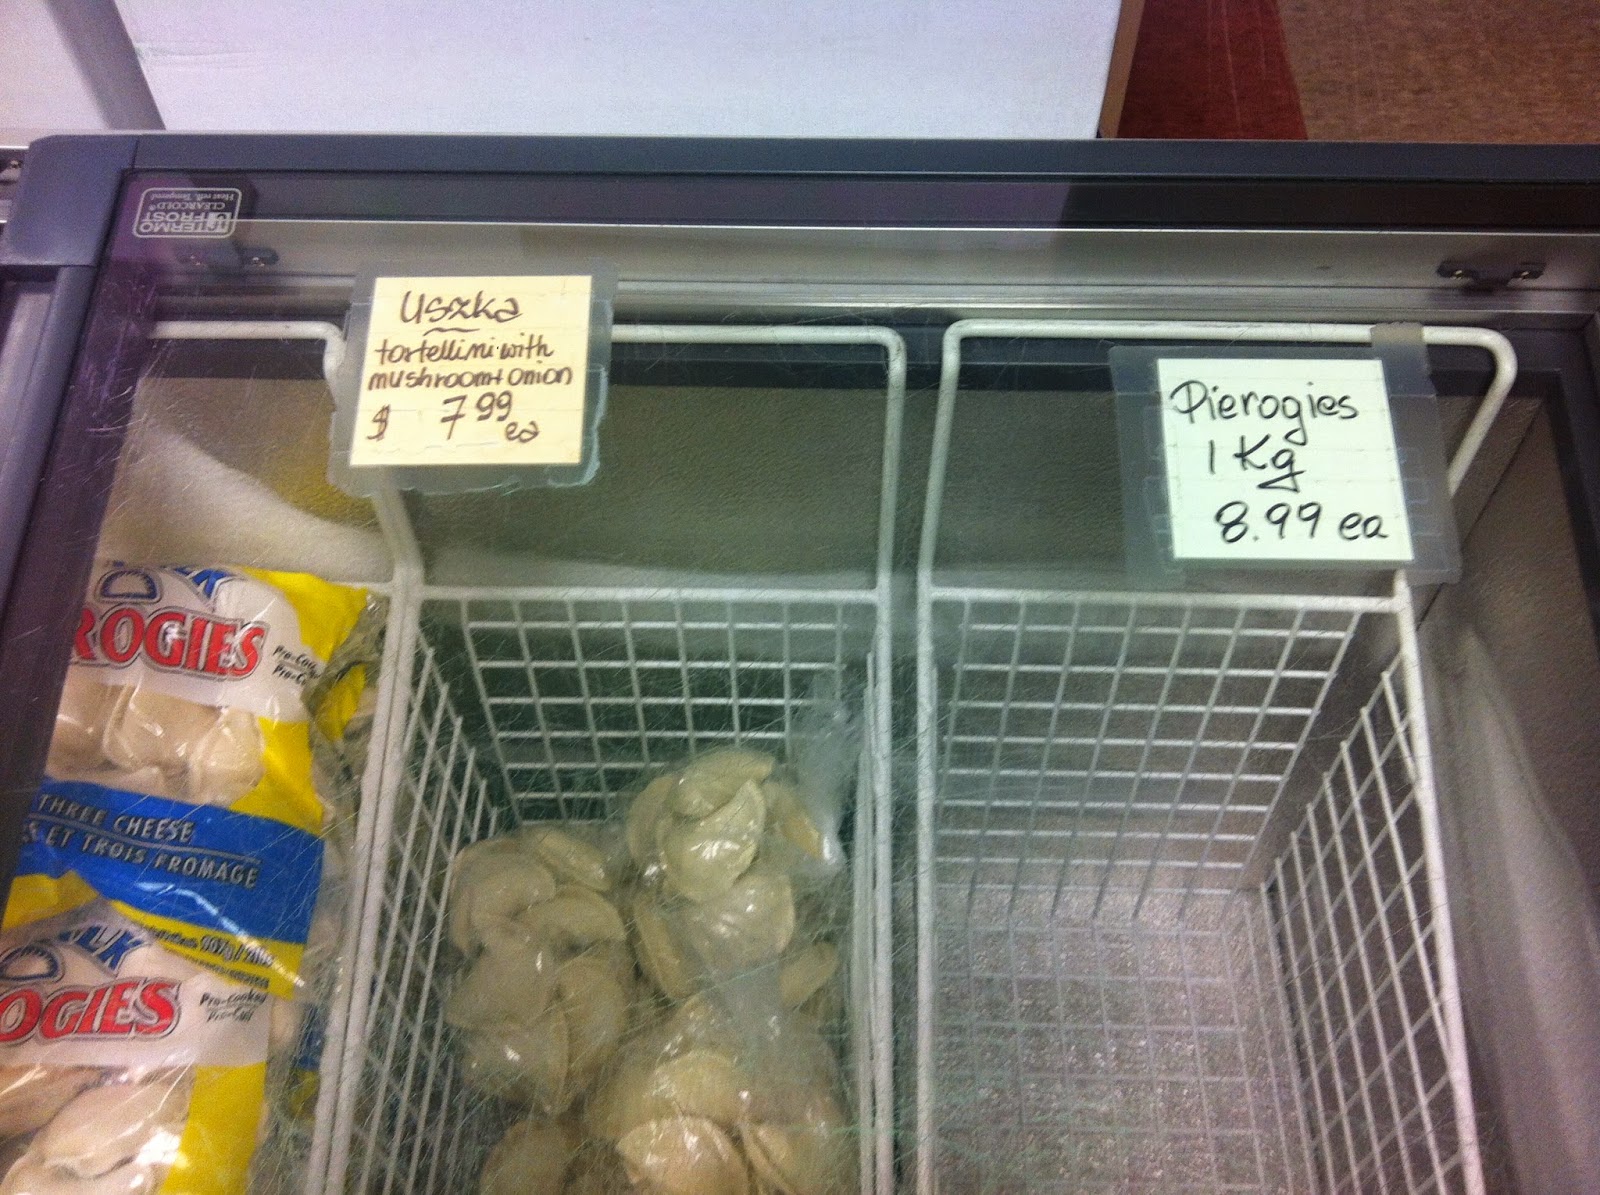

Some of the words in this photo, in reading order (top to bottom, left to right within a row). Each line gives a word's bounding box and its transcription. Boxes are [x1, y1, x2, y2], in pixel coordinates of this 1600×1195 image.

[139, 222, 207, 233] TERMO
[140, 211, 206, 222] FROST
[400, 289, 523, 324] Uszka
[499, 331, 554, 361] with
[1169, 379, 1359, 446] Pierogies
[504, 420, 539, 443] ea
[1214, 500, 1322, 544] 8.99
[1338, 512, 1389, 541] ea
[37, 793, 108, 826] THREE
[112, 814, 196, 844] CHEESE
[45, 825, 76, 849] ET
[82, 833, 148, 865] TROIS
[154, 853, 261, 890] FROMAGE
